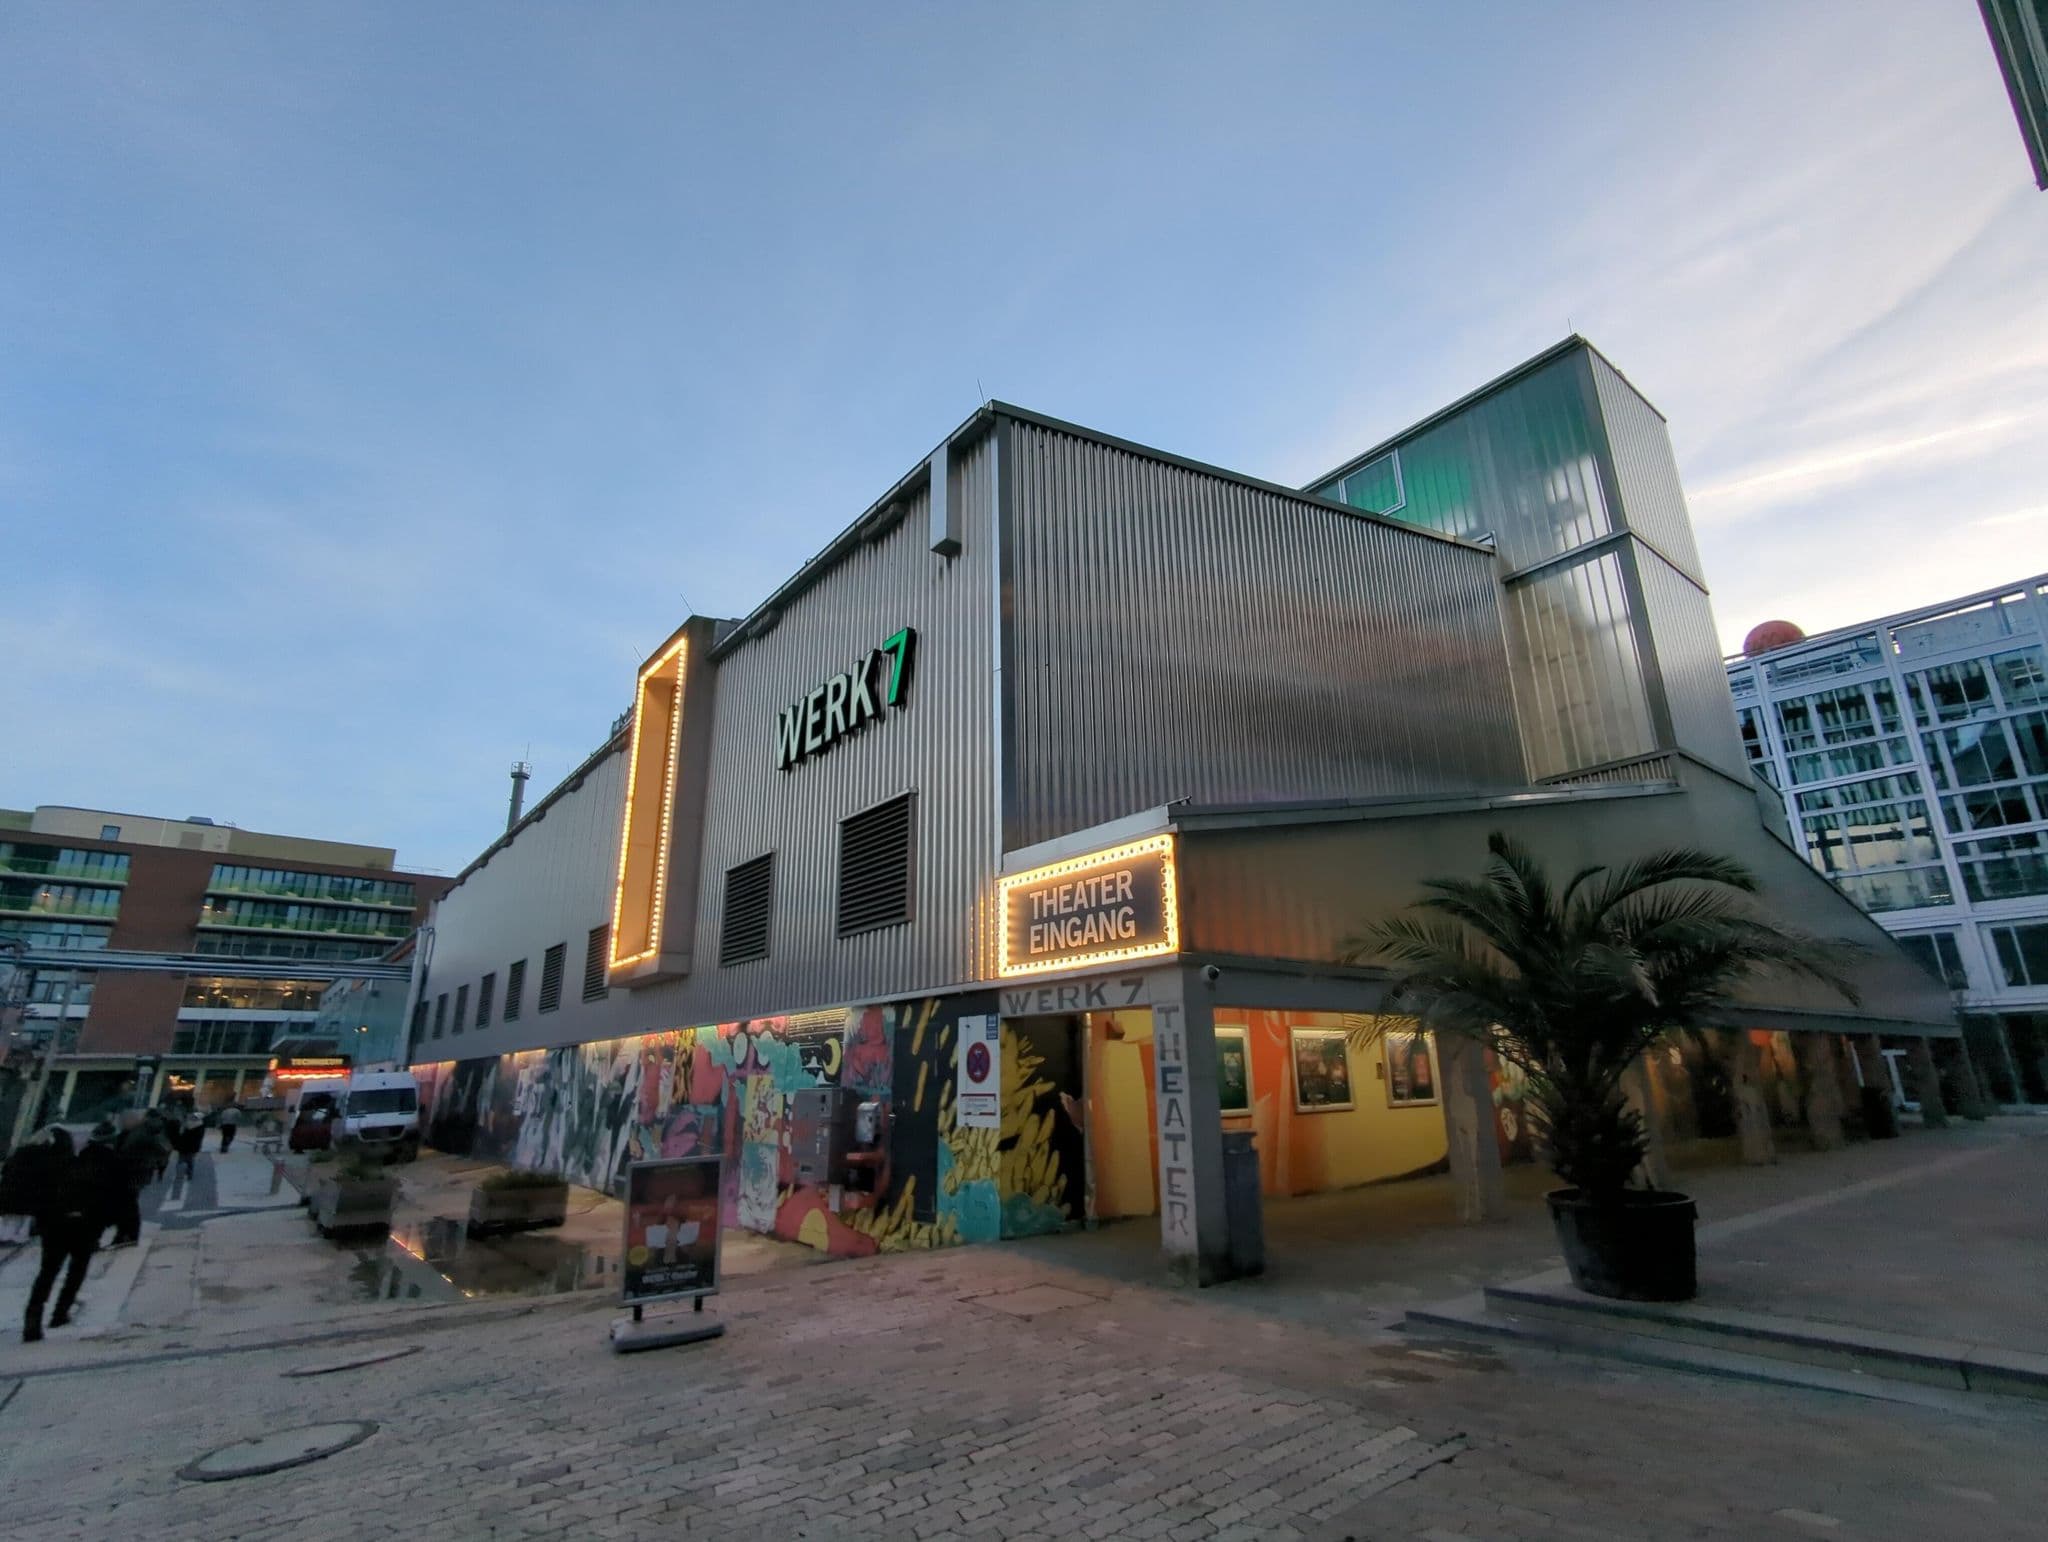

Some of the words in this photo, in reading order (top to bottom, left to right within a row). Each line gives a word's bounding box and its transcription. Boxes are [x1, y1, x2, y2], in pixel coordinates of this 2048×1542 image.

[776, 649, 876, 769] WERK
[882, 627, 911, 706] 7
[1029, 870, 1134, 920] THEATER
[1030, 906, 1136, 954] EINGANG
[1006, 981, 1107, 1015] WERK
[1120, 976, 1144, 1005] 7
[1157, 1005, 1189, 1236] THEATER
